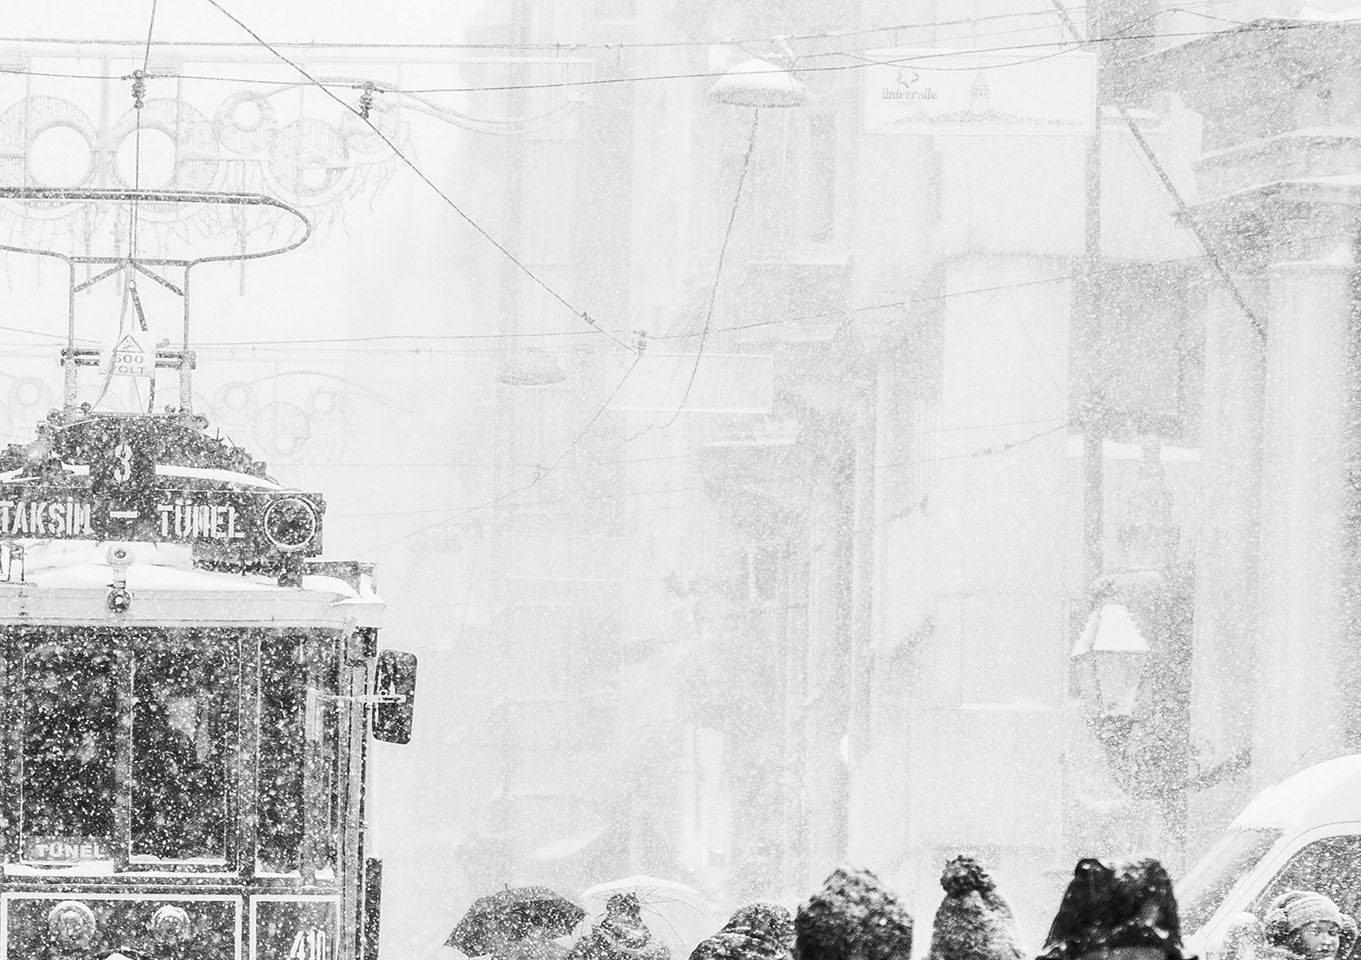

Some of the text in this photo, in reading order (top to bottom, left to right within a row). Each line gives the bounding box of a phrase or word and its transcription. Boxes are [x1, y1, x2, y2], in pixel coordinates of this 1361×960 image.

[111, 366, 147, 374] OLT
[114, 444, 133, 482] 3
[157, 500, 245, 539] TÜNEL
